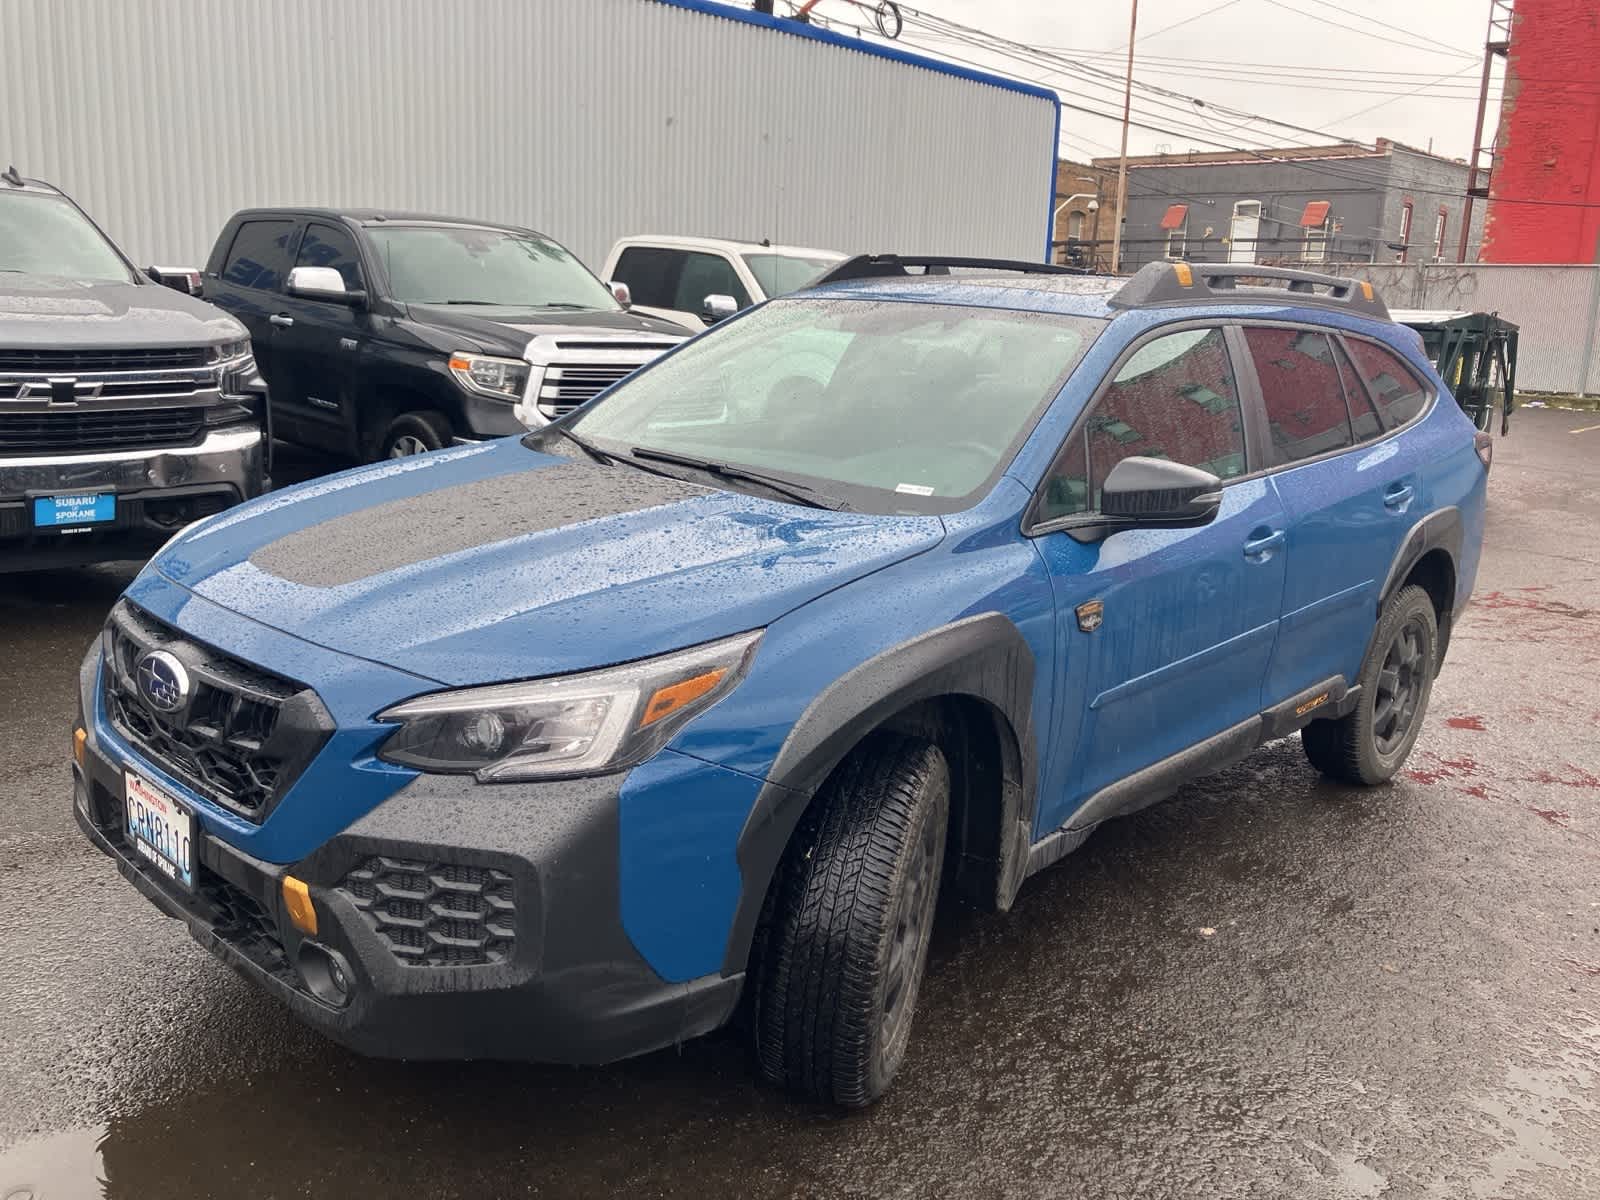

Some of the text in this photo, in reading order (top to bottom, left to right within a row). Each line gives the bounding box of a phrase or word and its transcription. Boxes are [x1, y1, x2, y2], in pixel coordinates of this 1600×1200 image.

[55, 496, 96, 507] SUBARU
[55, 509, 96, 519] SPOKANE
[128, 779, 168, 814] WASHINGTON
